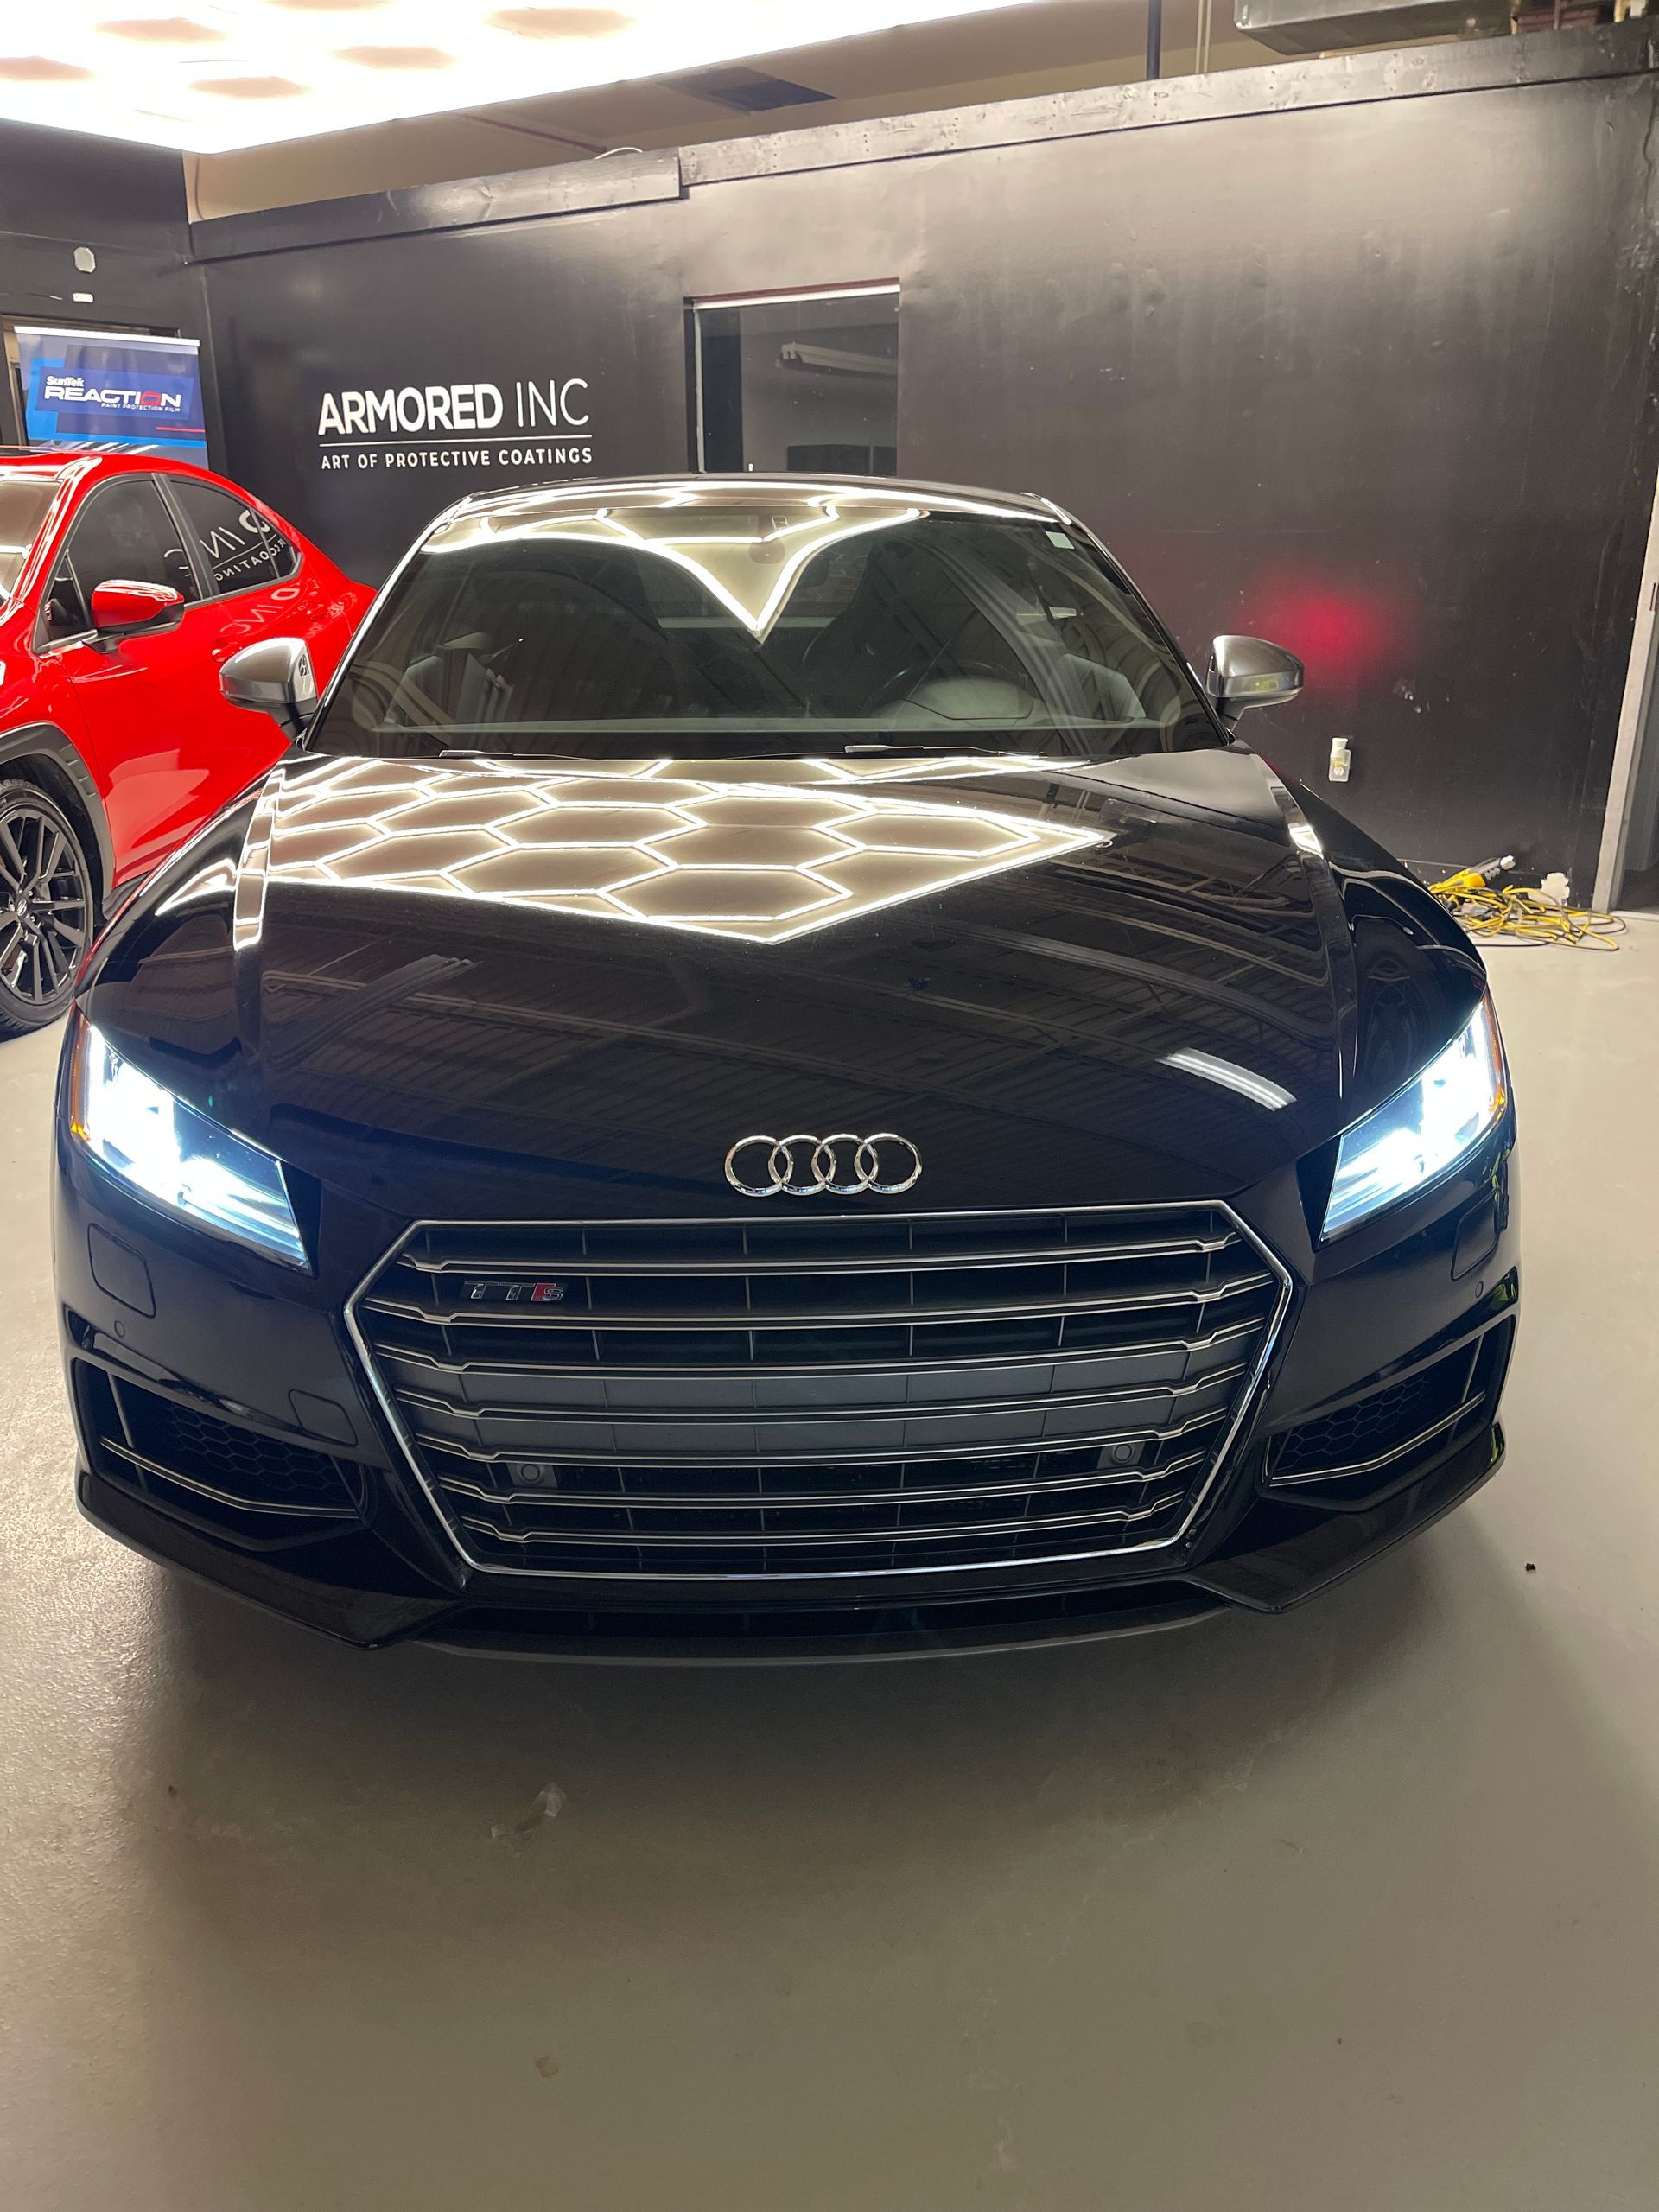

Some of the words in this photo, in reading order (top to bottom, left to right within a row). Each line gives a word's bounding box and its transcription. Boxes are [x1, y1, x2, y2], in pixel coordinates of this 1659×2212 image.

[47, 375, 85, 387] SunTek
[44, 386, 181, 408] REACTION
[317, 383, 504, 435] ARMORED
[516, 378, 589, 428] INC
[123, 404, 163, 412] PROTECTION
[321, 454, 350, 469] ART
[357, 454, 378, 469] OF
[385, 449, 491, 467] PROTECTIVE
[499, 448, 593, 466] COATINGS
[464, 1281, 564, 1301] TTS
